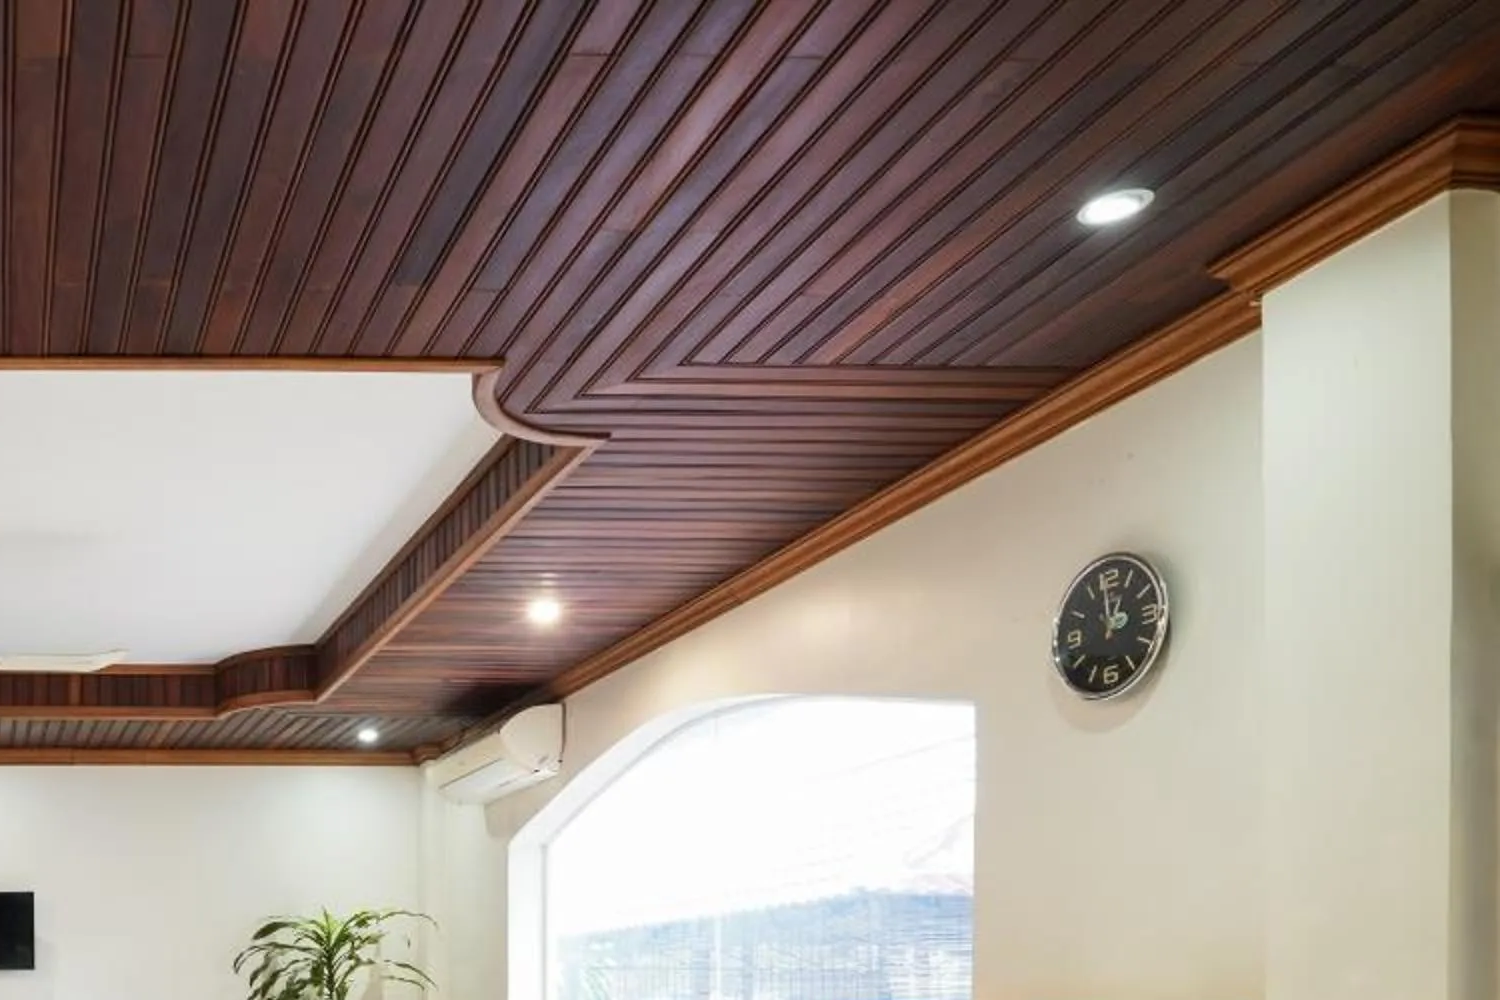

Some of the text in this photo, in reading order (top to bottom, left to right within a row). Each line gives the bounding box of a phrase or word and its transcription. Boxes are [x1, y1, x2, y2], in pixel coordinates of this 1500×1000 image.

[1141, 603, 1157, 625] 3
[1067, 630, 1082, 649] 9
[1103, 665, 1119, 684] 6
